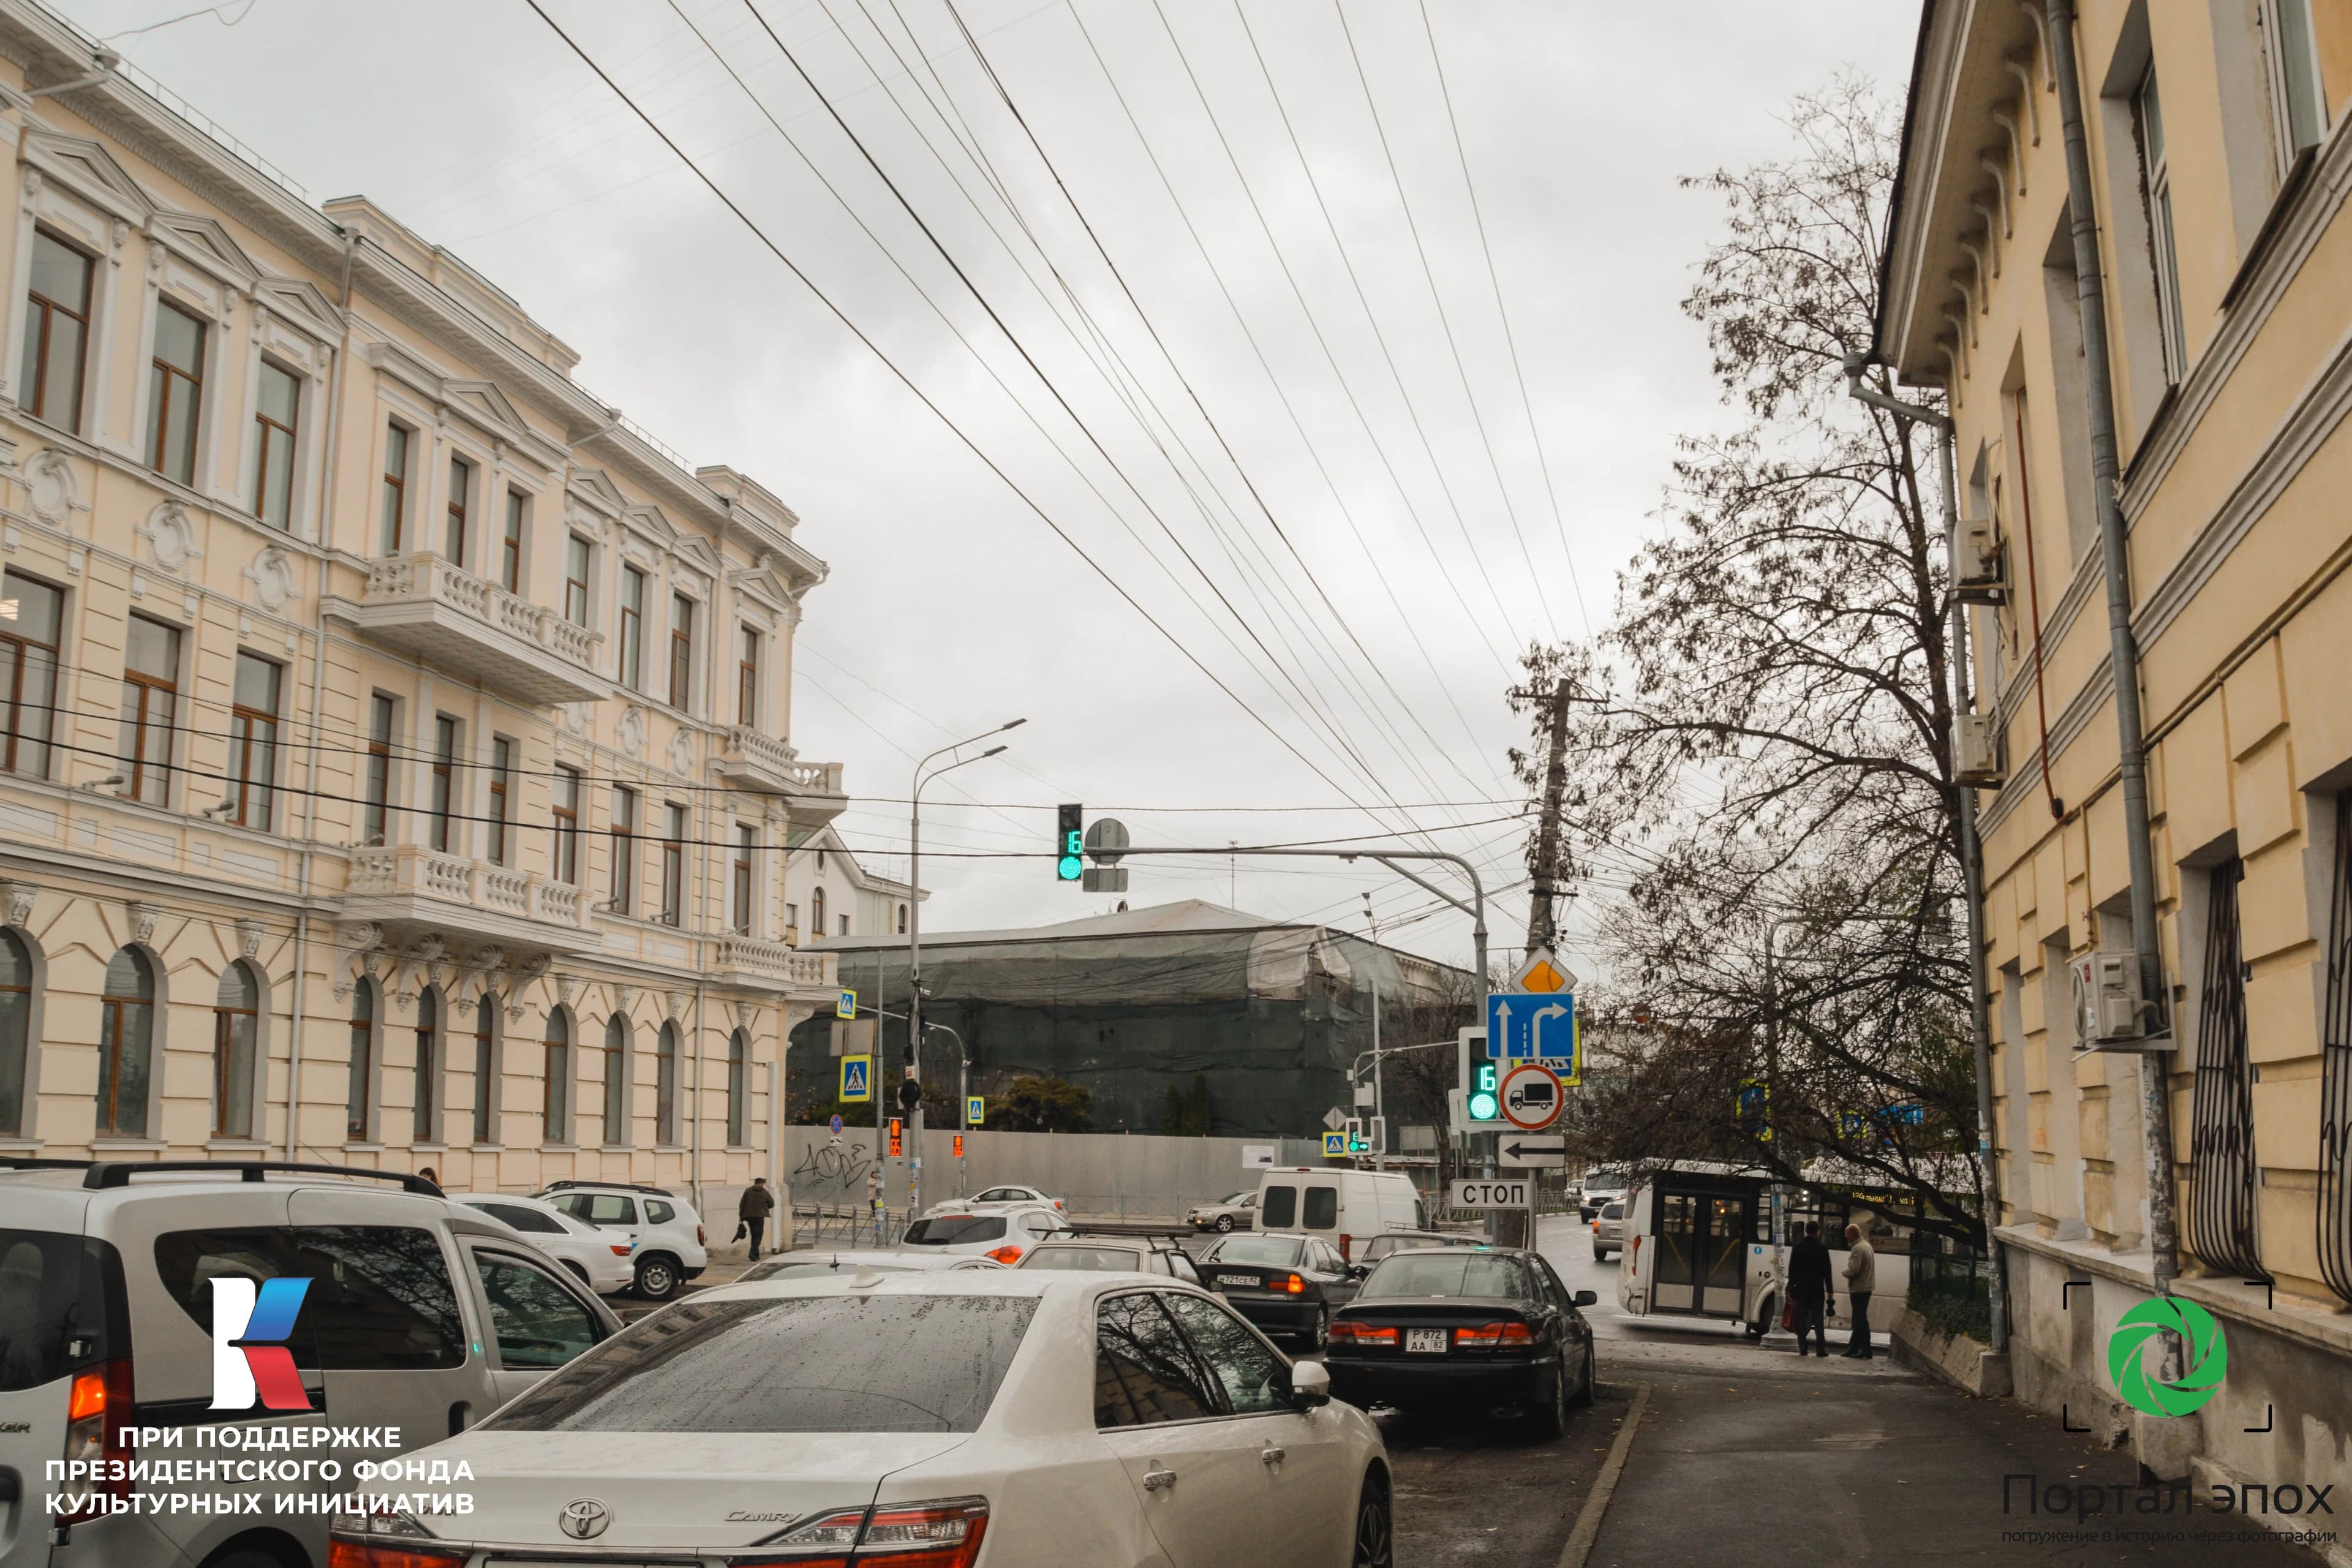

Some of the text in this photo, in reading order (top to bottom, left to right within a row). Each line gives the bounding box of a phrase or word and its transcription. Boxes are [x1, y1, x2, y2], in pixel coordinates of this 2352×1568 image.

[1480, 1066, 1496, 1091] 16
[1463, 1185, 1523, 1204] СТОП
[1423, 1330, 1441, 1340] 872
[725, 1510, 803, 1523] CAMRY
